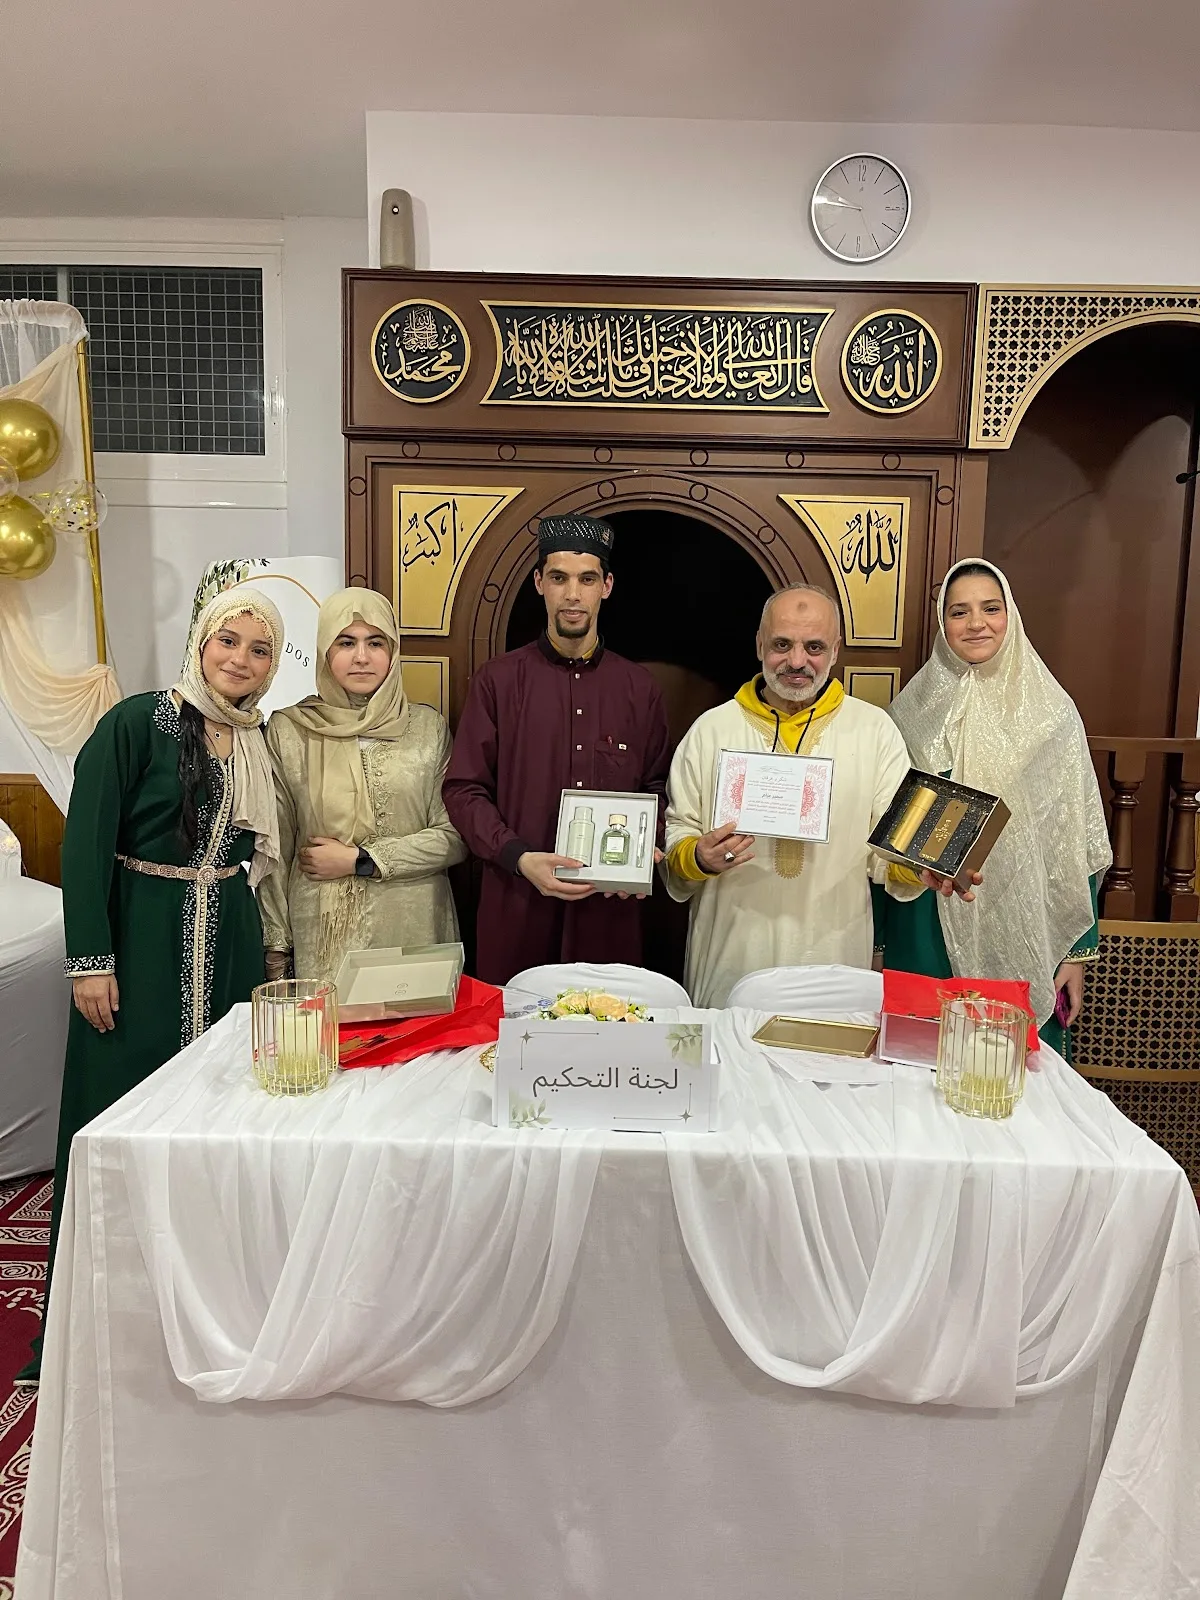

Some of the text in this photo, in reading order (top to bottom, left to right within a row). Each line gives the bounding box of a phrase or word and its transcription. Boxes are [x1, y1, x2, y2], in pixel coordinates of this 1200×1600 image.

[858, 164, 867, 182] 12
[840, 508, 897, 584] الله
[532, 1066, 678, 1098] لجنة التحكيم
